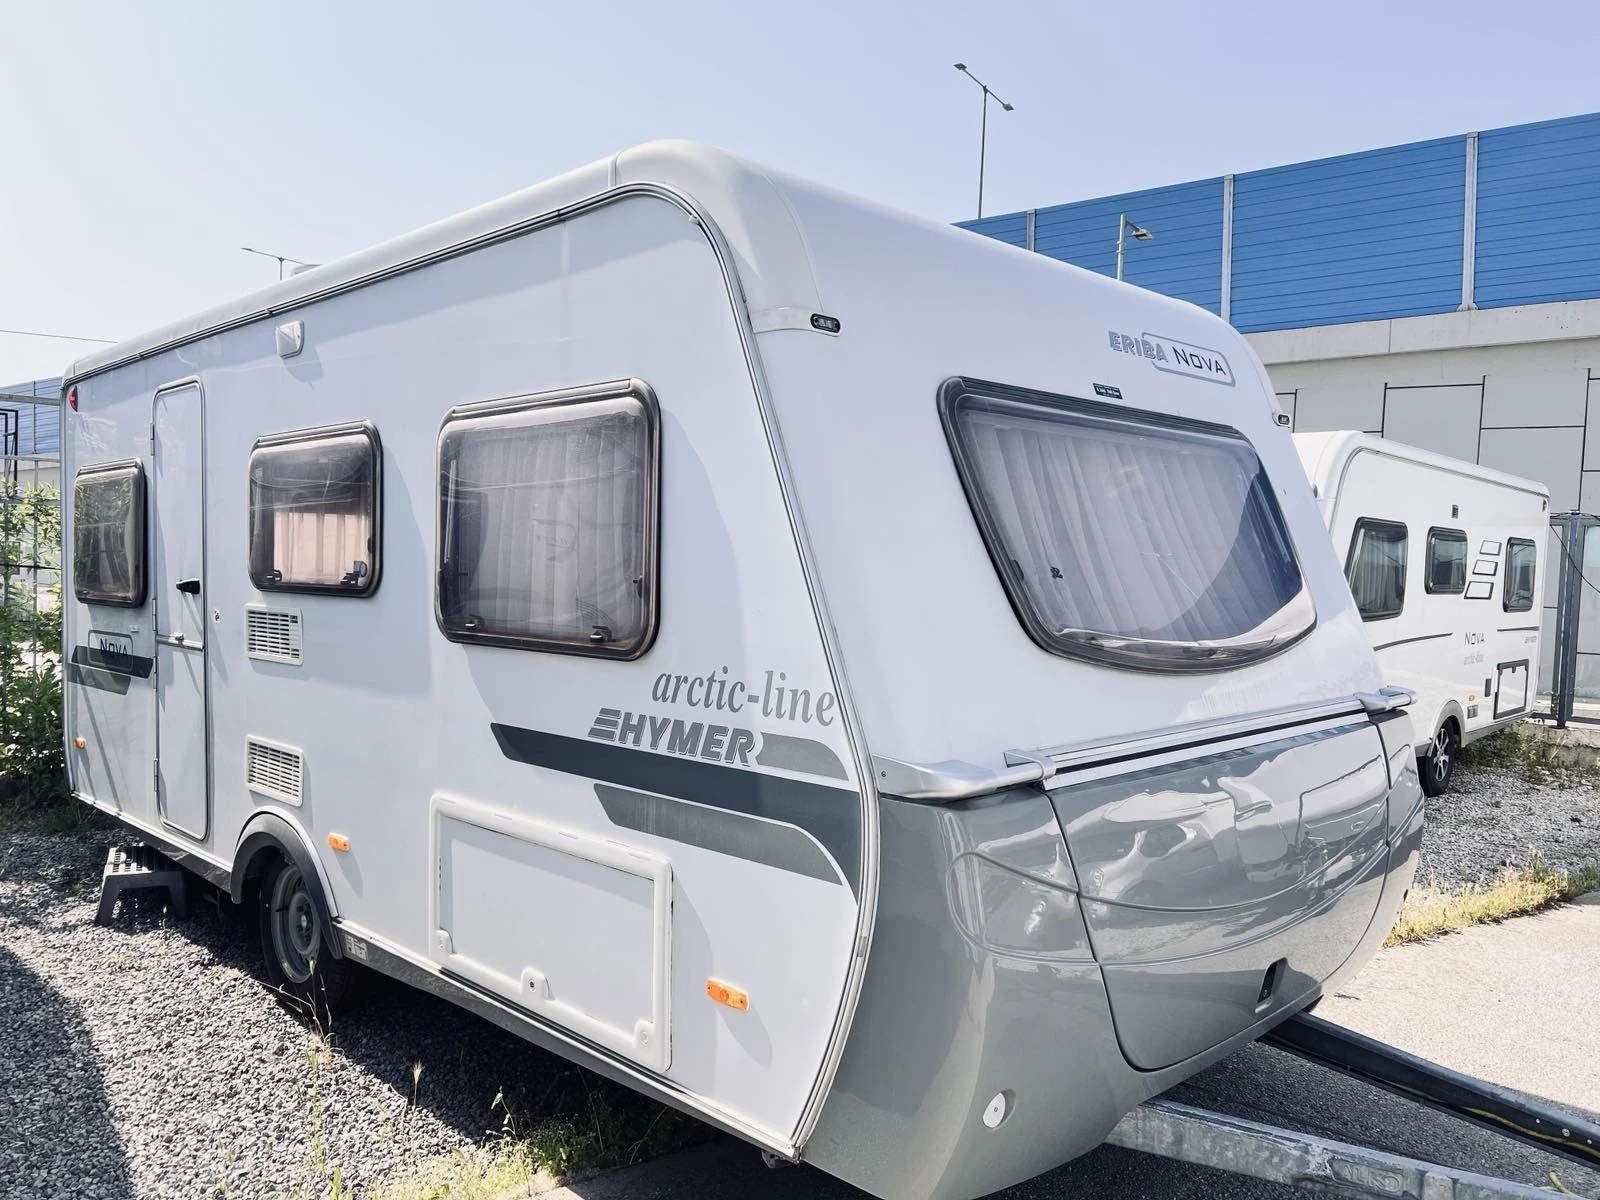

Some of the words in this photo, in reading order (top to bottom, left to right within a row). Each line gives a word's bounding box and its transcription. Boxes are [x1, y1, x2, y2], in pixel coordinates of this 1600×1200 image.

[1108, 331, 1168, 363] ERIBA
[1171, 346, 1227, 376] NOVA
[100, 637, 128, 657] NOVA
[1464, 631, 1486, 646] NOVA
[651, 665, 835, 727] arctic-line
[617, 711, 756, 767] HYMER
